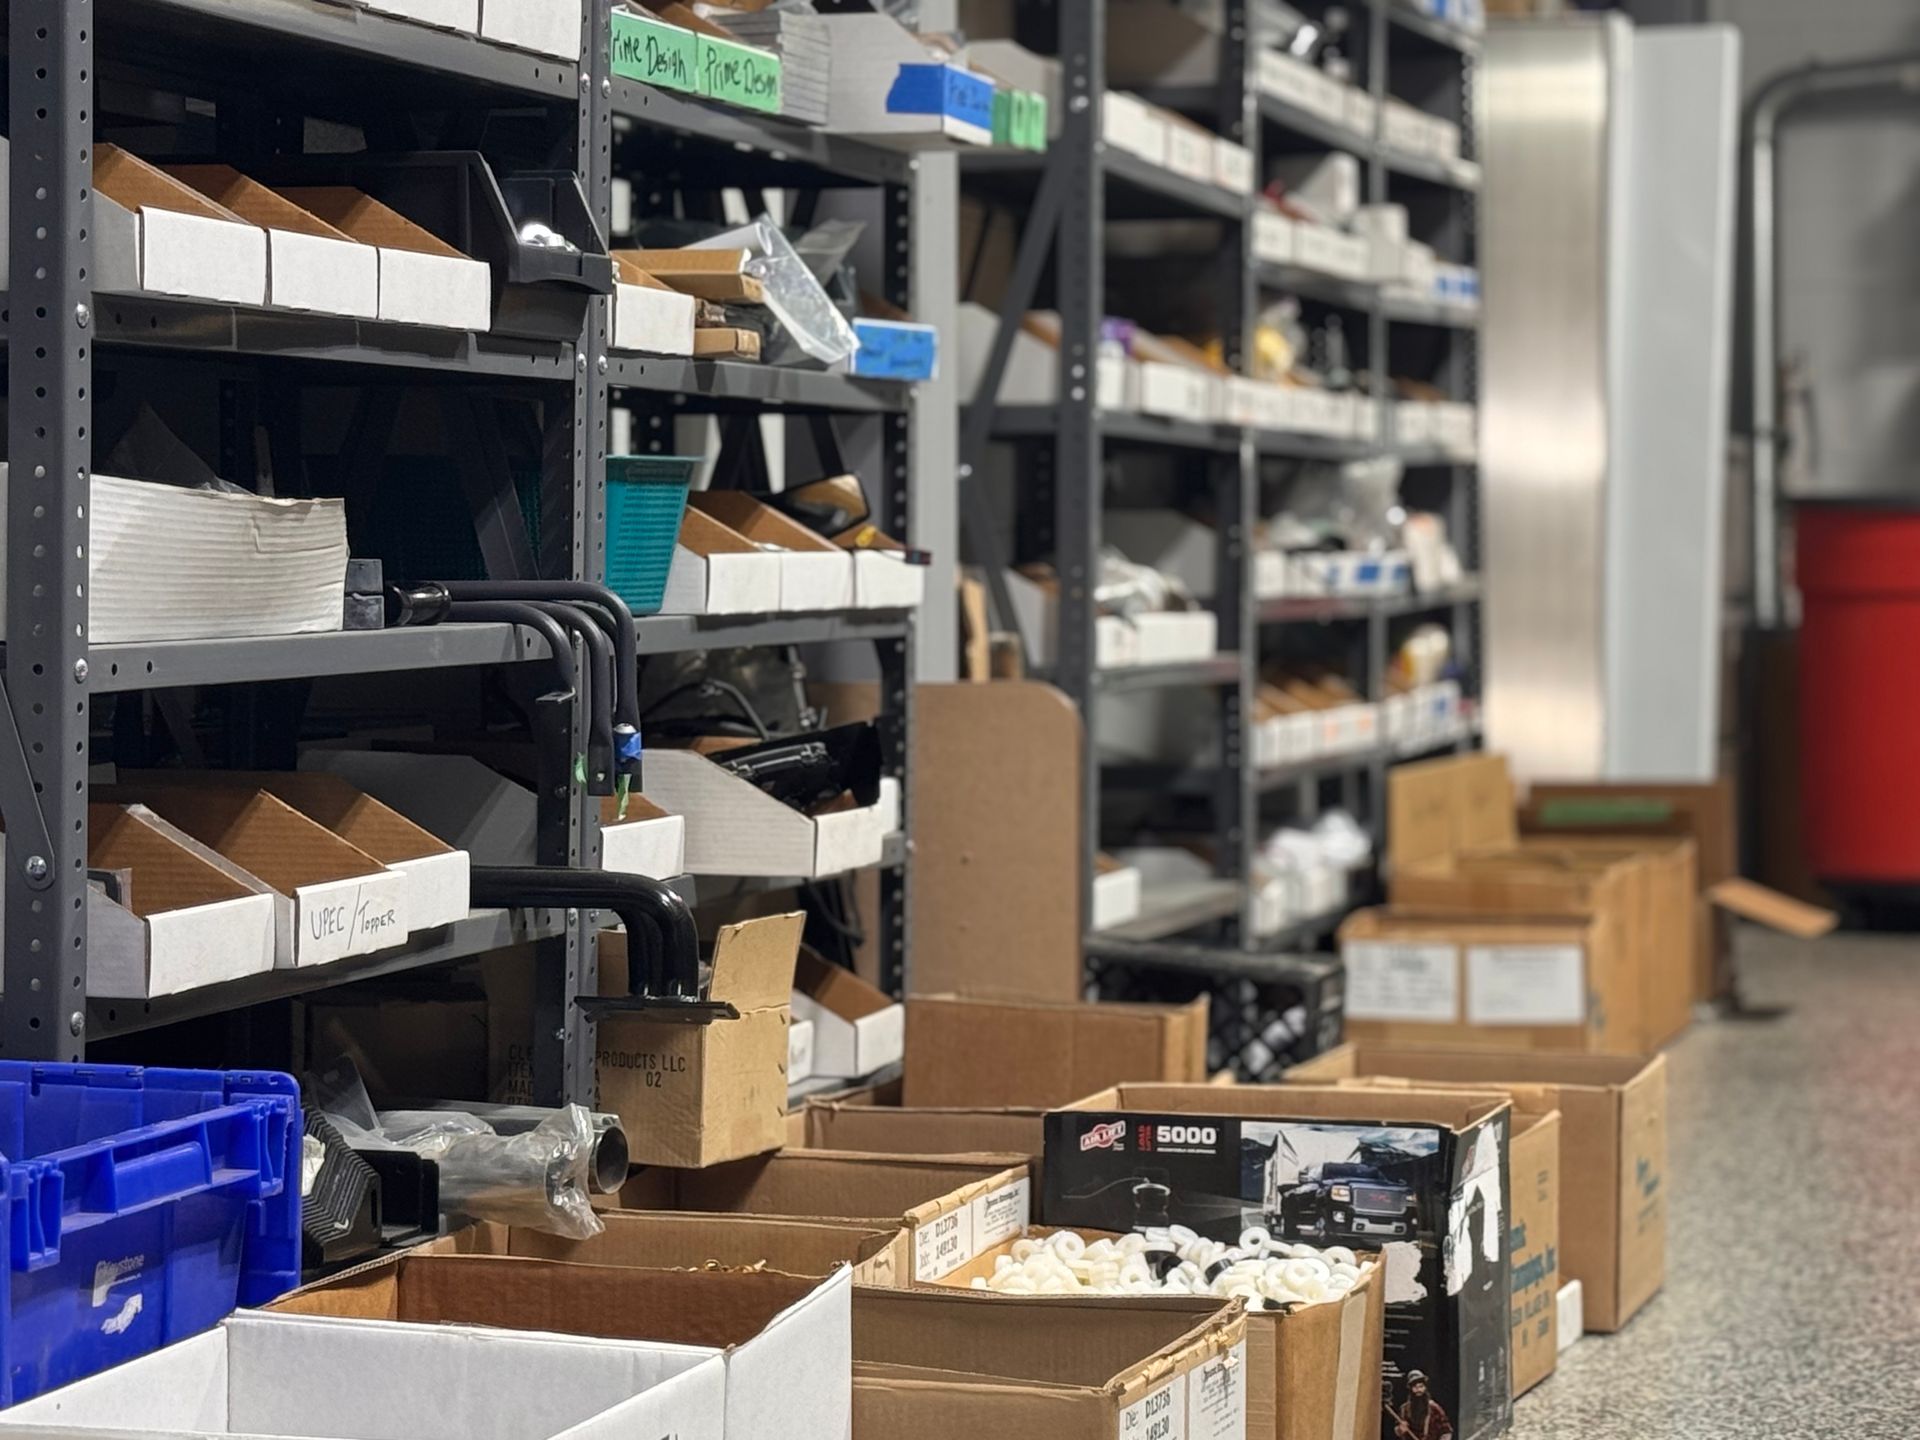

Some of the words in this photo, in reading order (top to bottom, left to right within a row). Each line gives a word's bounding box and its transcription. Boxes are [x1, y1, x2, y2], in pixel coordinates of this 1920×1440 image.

[645, 34, 687, 85] Design
[705, 46, 741, 97] Prime
[595, 1051, 657, 1070] PRODUCTS
[661, 1056, 686, 1073] LLC
[645, 1071, 663, 1088] 02
[1156, 1125, 1217, 1145] 5000
